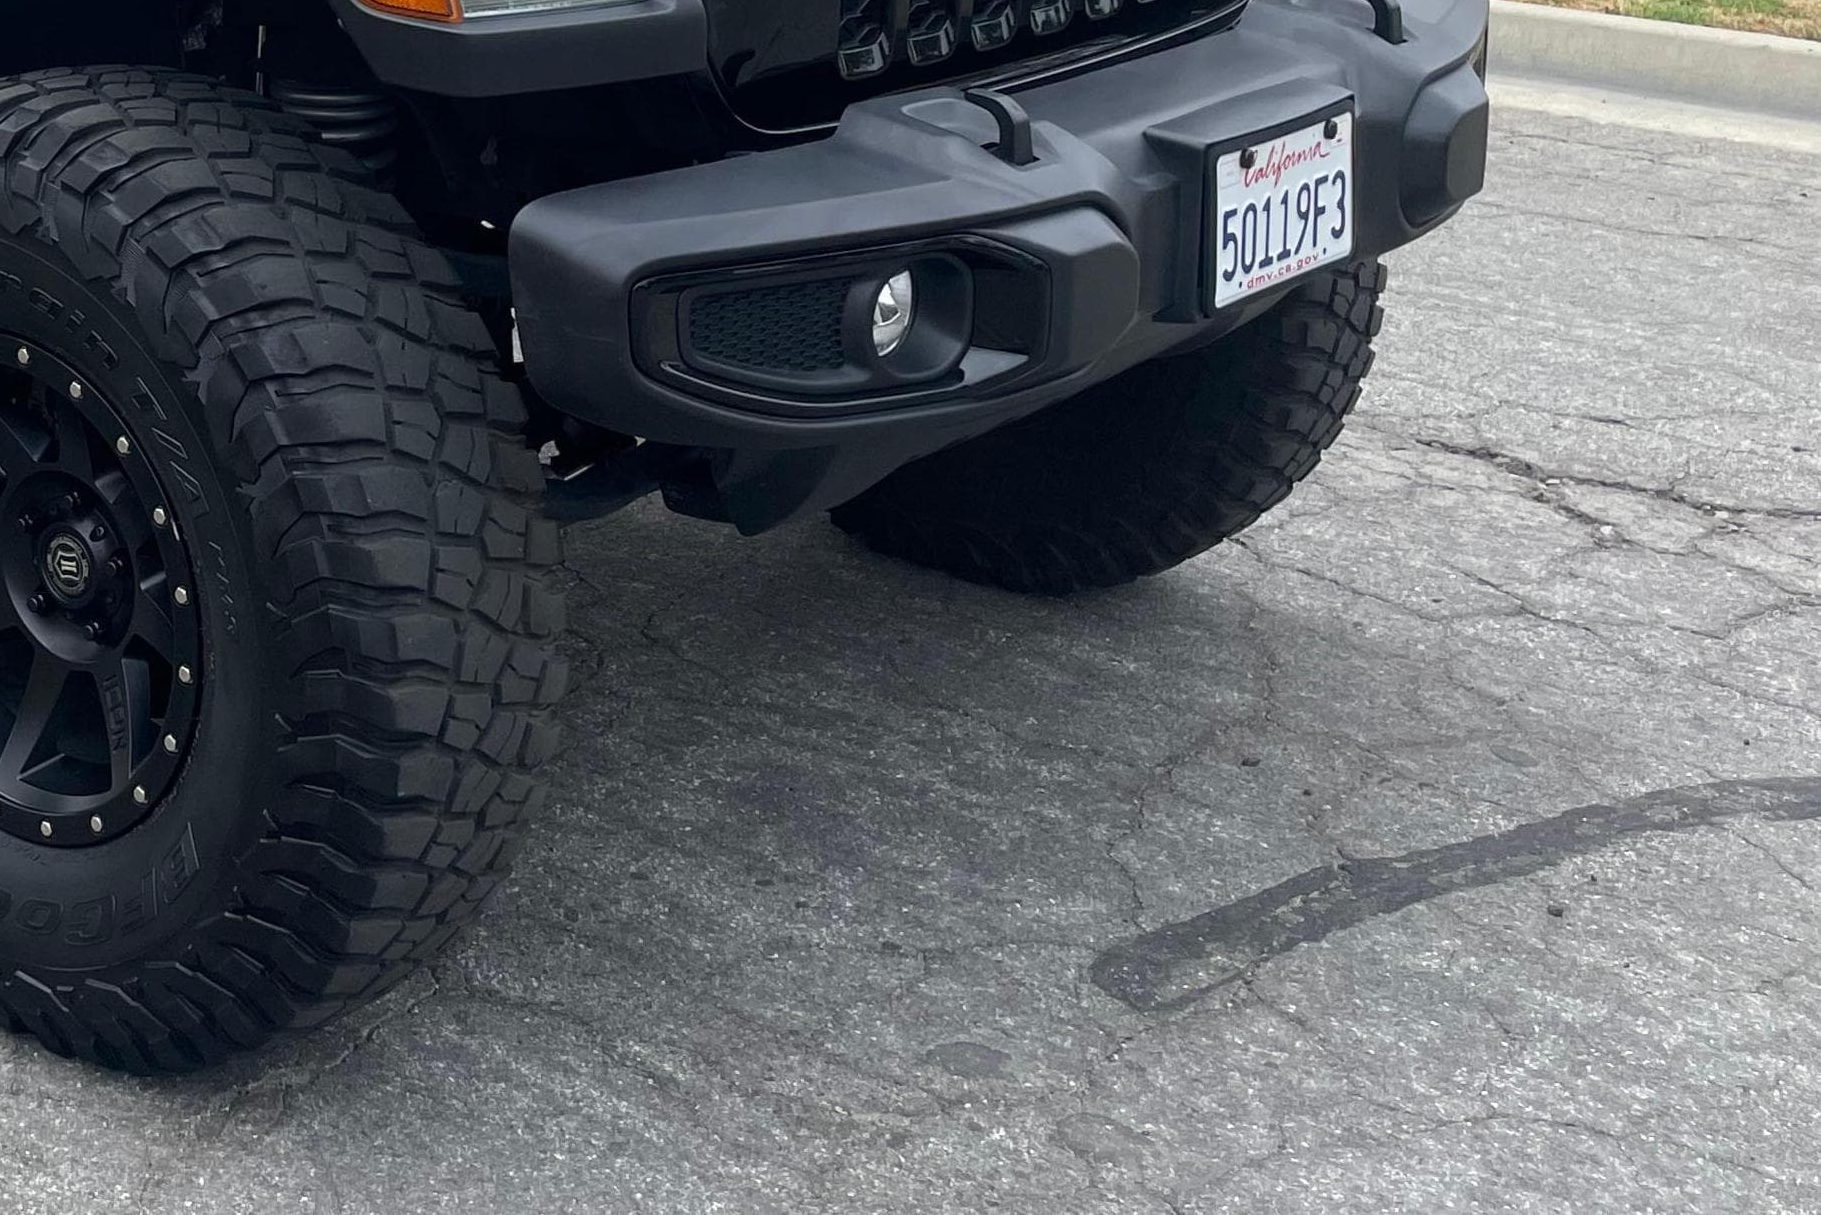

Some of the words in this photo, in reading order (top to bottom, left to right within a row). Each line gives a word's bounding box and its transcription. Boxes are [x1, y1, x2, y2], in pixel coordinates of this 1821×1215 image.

[1243, 140, 1330, 187] California
[1222, 169, 1346, 282] 50119F3
[1246, 252, 1320, 290] dmv.ca.gov
[130, 376, 210, 517] T/A
